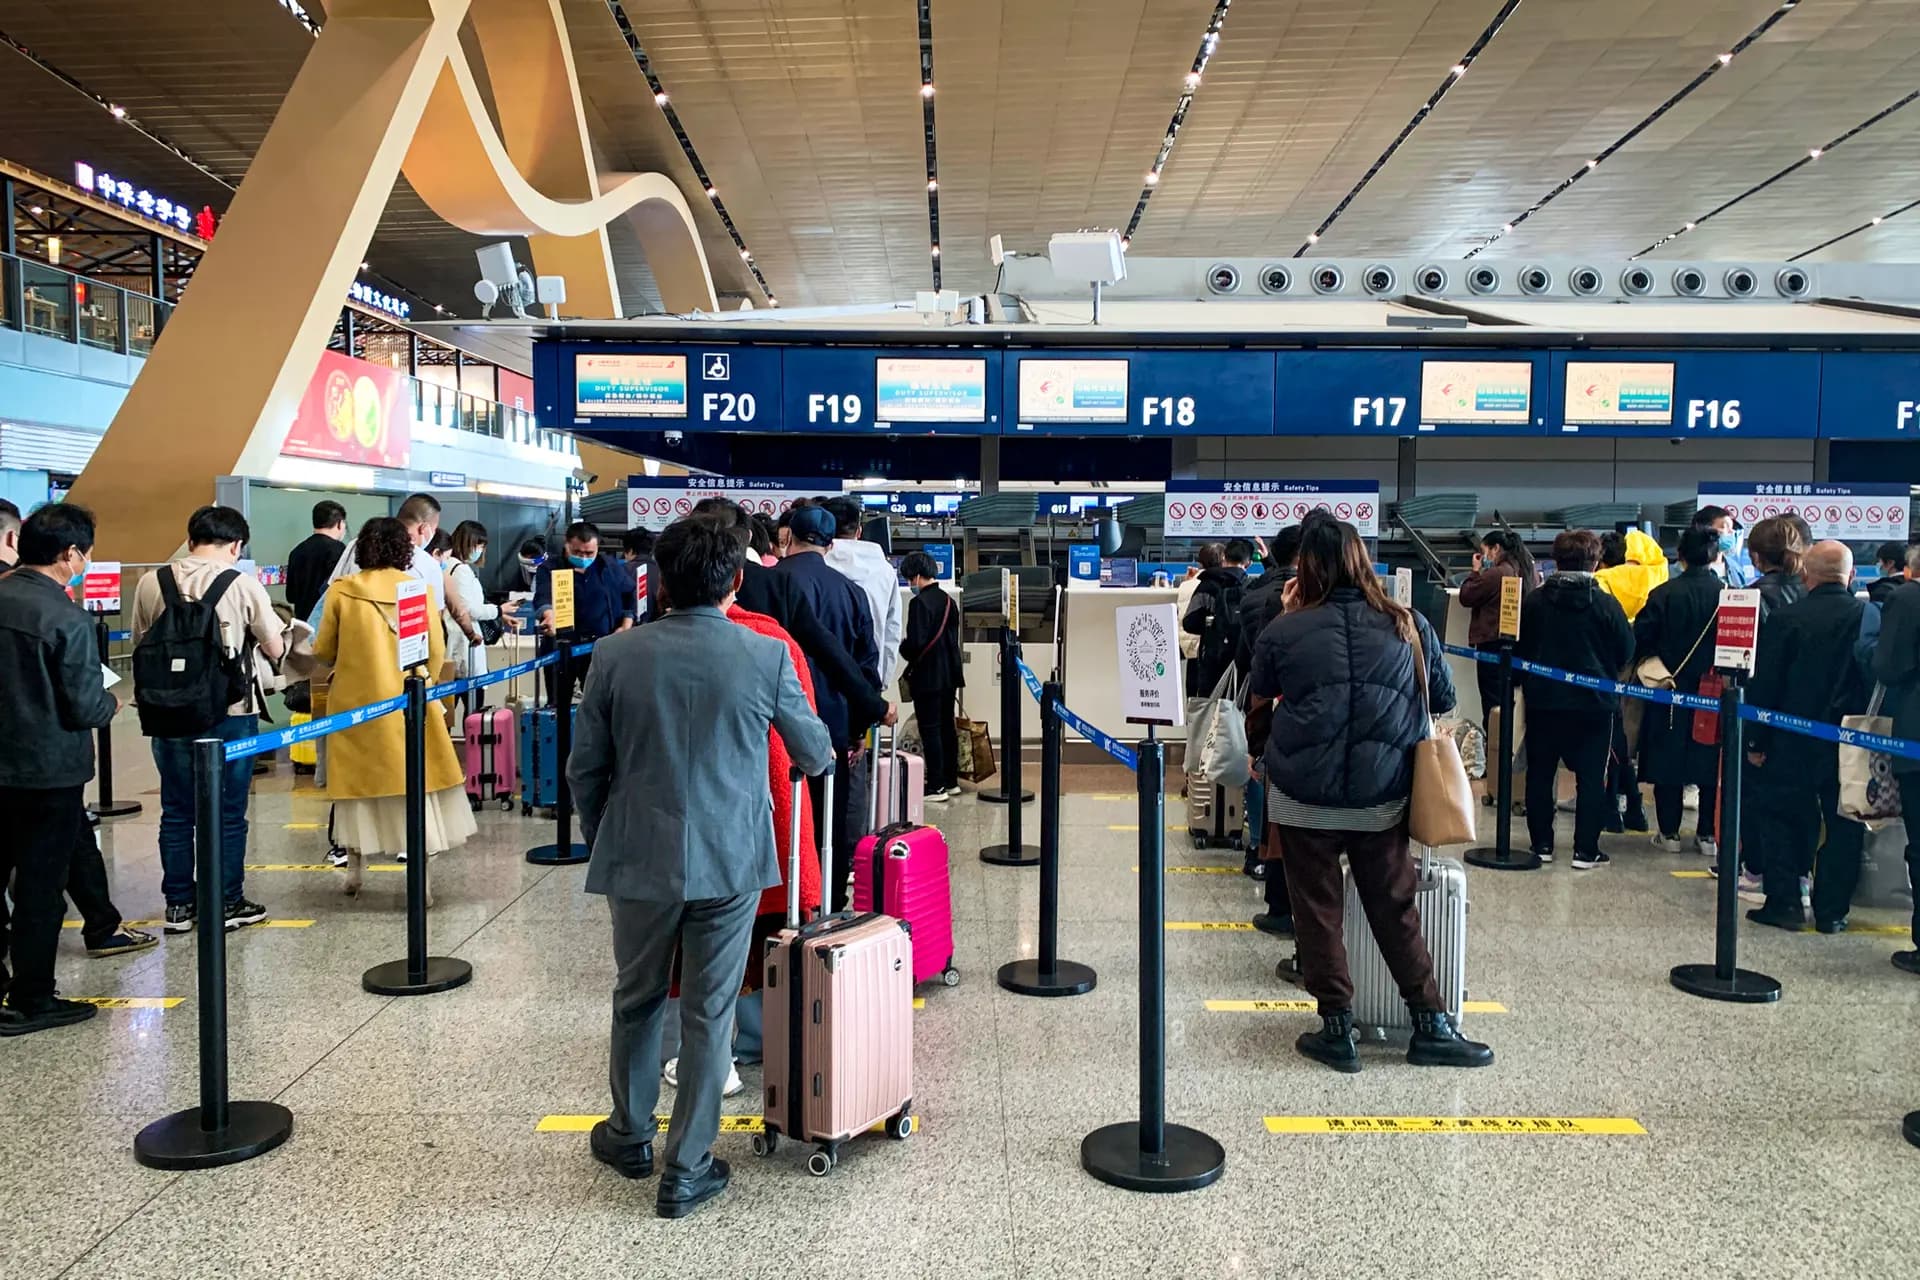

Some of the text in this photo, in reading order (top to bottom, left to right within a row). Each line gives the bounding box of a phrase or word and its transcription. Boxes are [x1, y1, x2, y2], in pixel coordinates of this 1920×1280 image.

[97, 173, 192, 231] 中华老字号
[349, 282, 410, 317] 物质文化遗产
[703, 393, 756, 422] F20
[808, 394, 862, 423] F19
[1143, 397, 1196, 426] F18
[1353, 397, 1406, 426] F17
[1688, 399, 1741, 429] F16
[688, 479, 784, 489] 安全信息提示 Safety Tips
[1224, 482, 1319, 493] 安全信息提示 Safety Tips
[1756, 485, 1812, 494] 安全信息提示
[890, 503, 907, 513] G20
[915, 503, 931, 513] G19
[1051, 504, 1068, 514] G17
